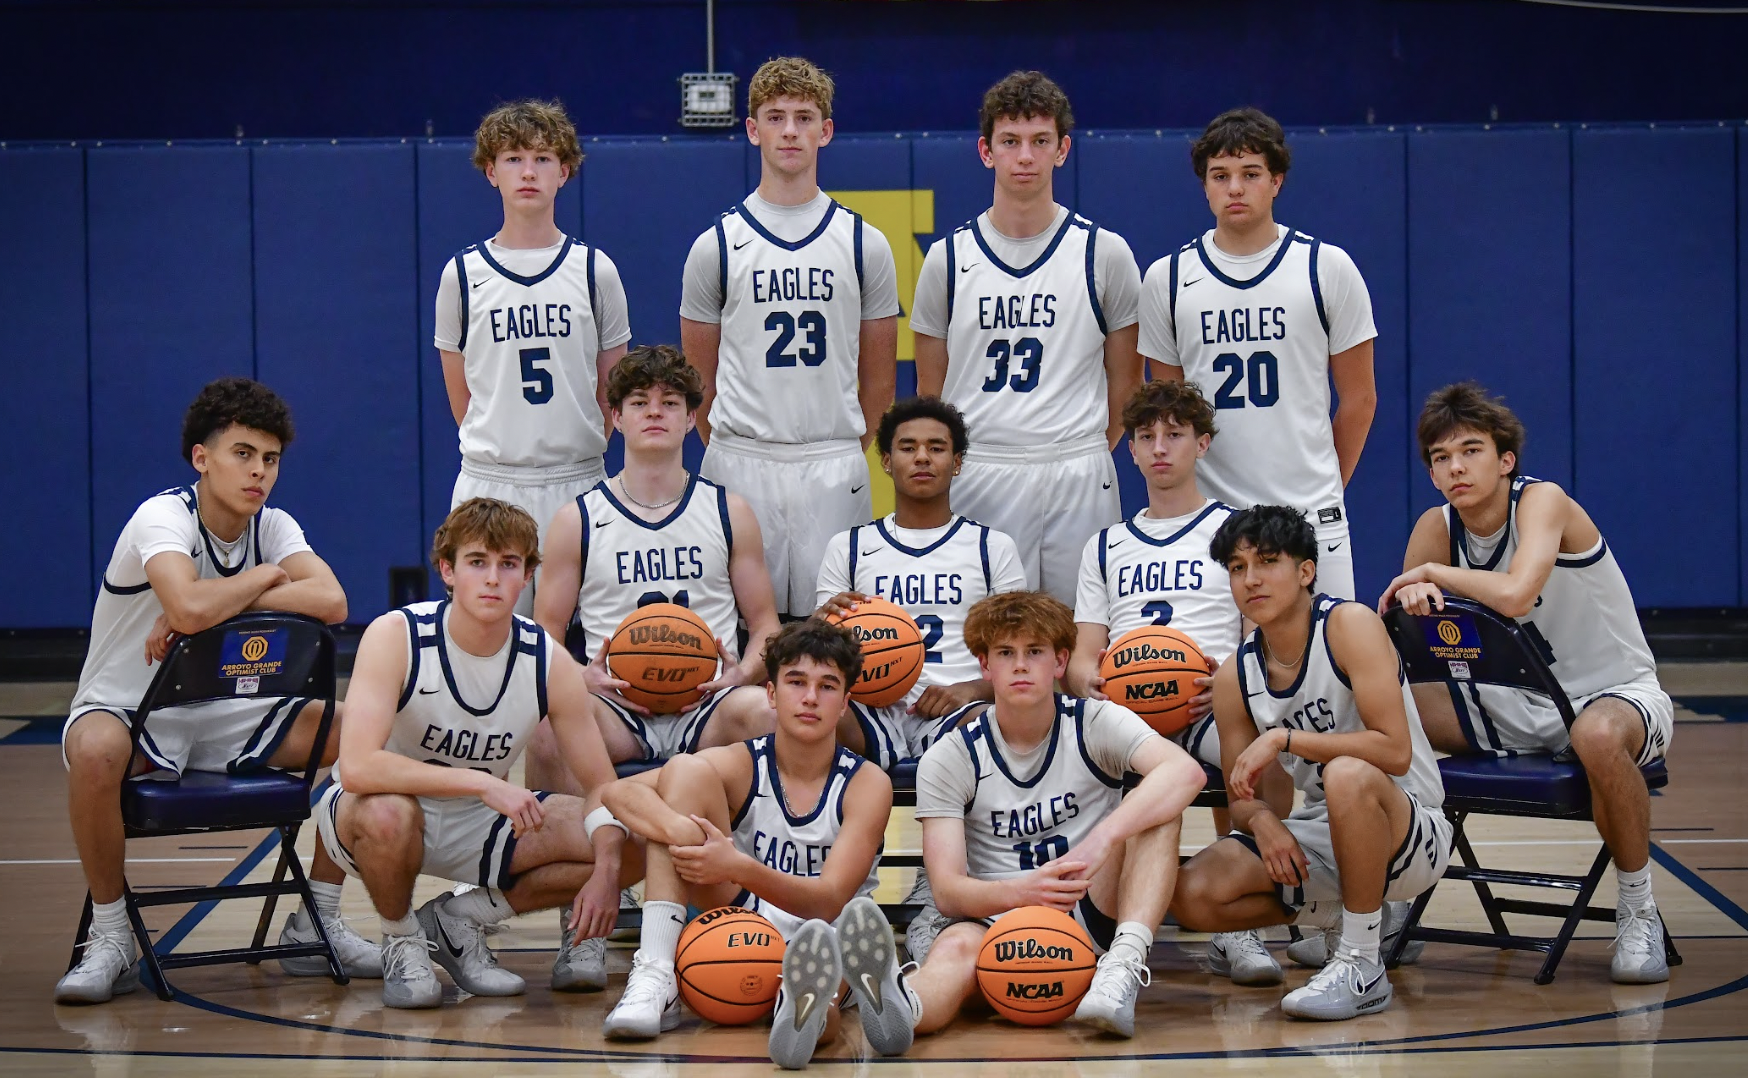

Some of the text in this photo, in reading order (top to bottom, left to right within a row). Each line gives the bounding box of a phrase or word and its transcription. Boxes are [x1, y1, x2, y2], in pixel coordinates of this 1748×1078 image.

[753, 267, 834, 303] EAGLES
[490, 304, 571, 343] EAGLES
[979, 294, 1056, 329] EAGLES
[1201, 307, 1286, 344] EAGLES
[764, 310, 827, 368] 23
[519, 347, 554, 405] 5
[981, 337, 1043, 393] 33
[1212, 351, 1279, 409] 20
[616, 546, 703, 585] EAGLES
[1118, 560, 1203, 598] EAGLES
[875, 574, 962, 605] EAGLES
[629, 624, 704, 651] Wilson
[1112, 643, 1186, 668] Wilson
[642, 666, 687, 683] EVO
[1125, 680, 1179, 700] NCAA
[420, 724, 513, 761] EAGLES
[991, 792, 1079, 838] EAGLES
[727, 932, 770, 948] EVO
[994, 938, 1073, 962] Wilson
[1006, 981, 1063, 999] NCAA
